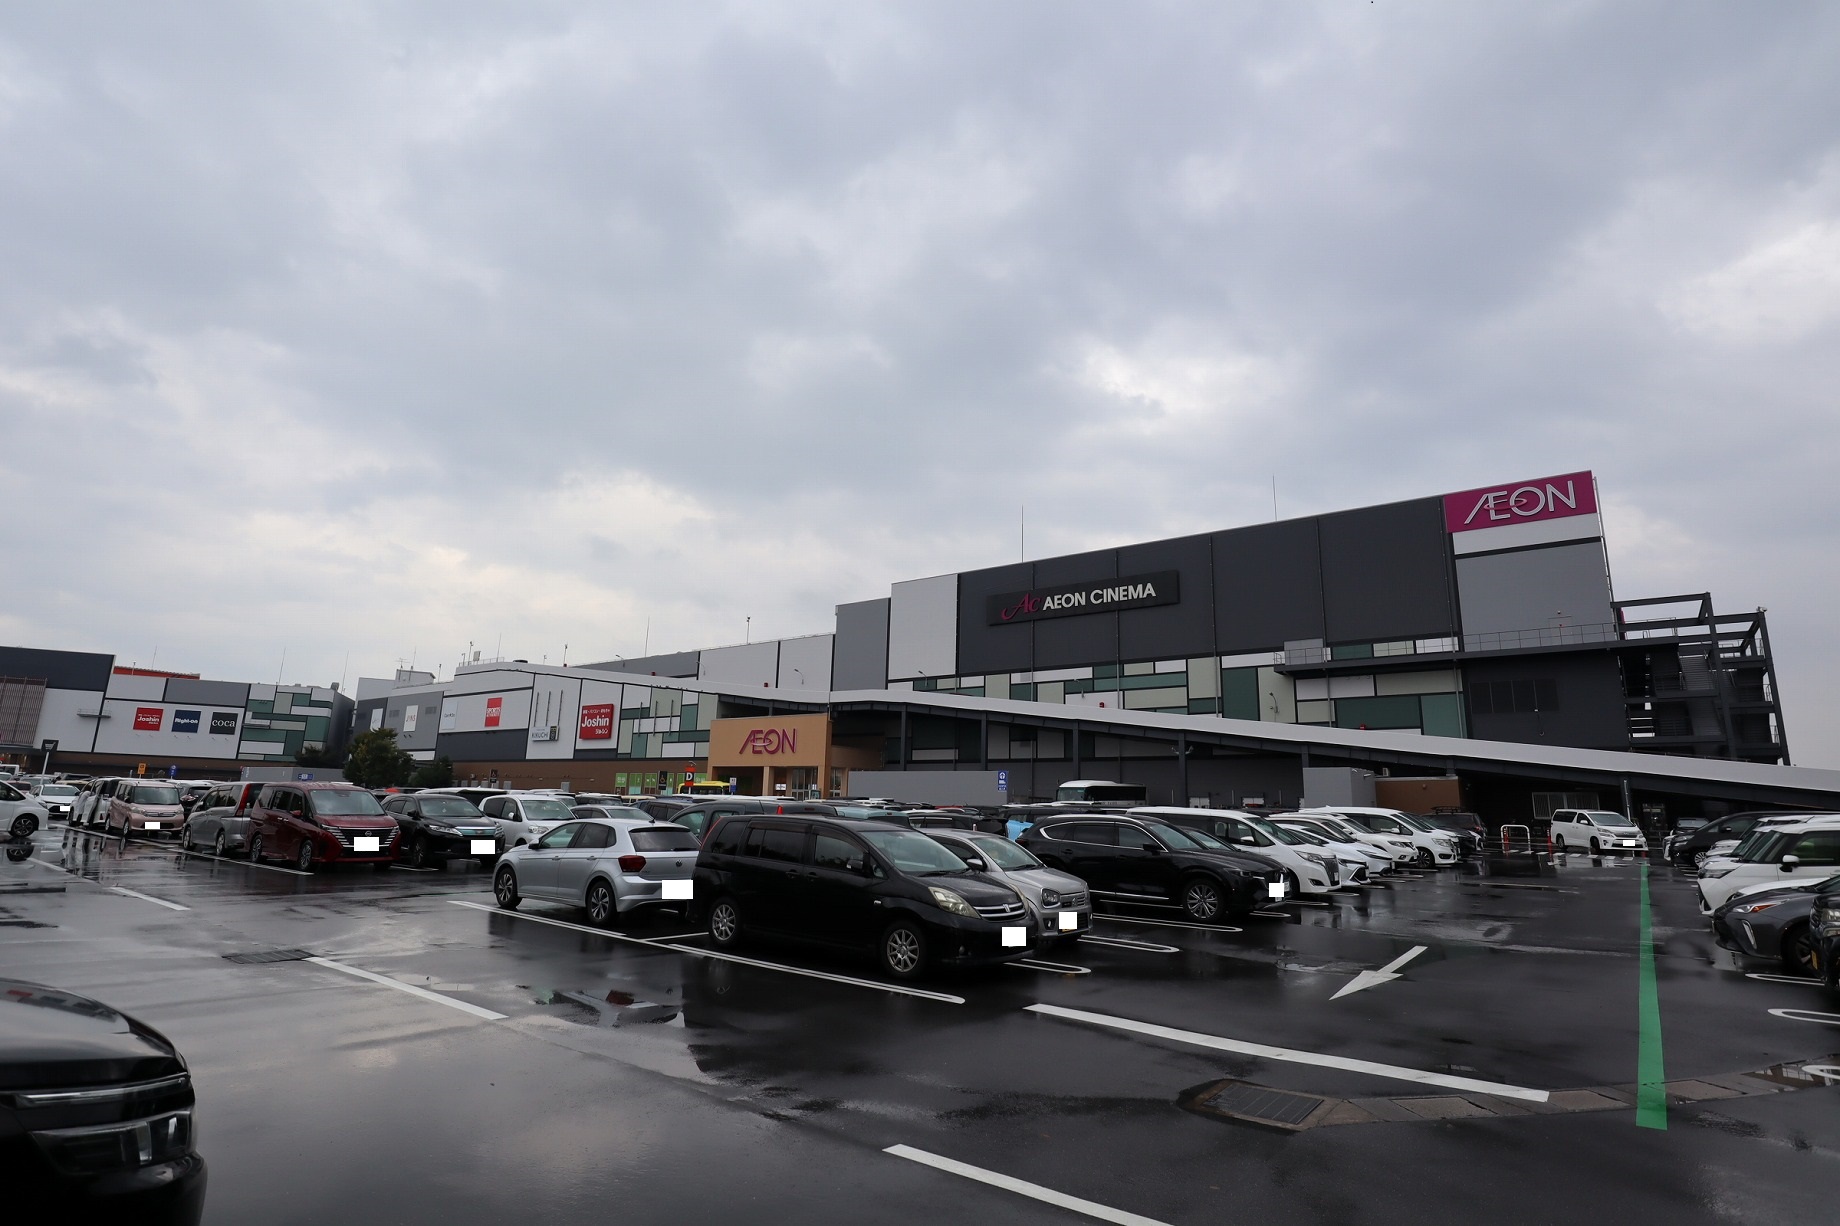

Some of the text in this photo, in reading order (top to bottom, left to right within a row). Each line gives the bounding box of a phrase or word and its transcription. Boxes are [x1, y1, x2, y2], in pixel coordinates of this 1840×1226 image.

[1043, 592, 1086, 610] AEON
[1090, 582, 1156, 605] CINEMA
[212, 719, 235, 727] coca
[581, 714, 610, 728] Joshin
[686, 772, 693, 780] D
